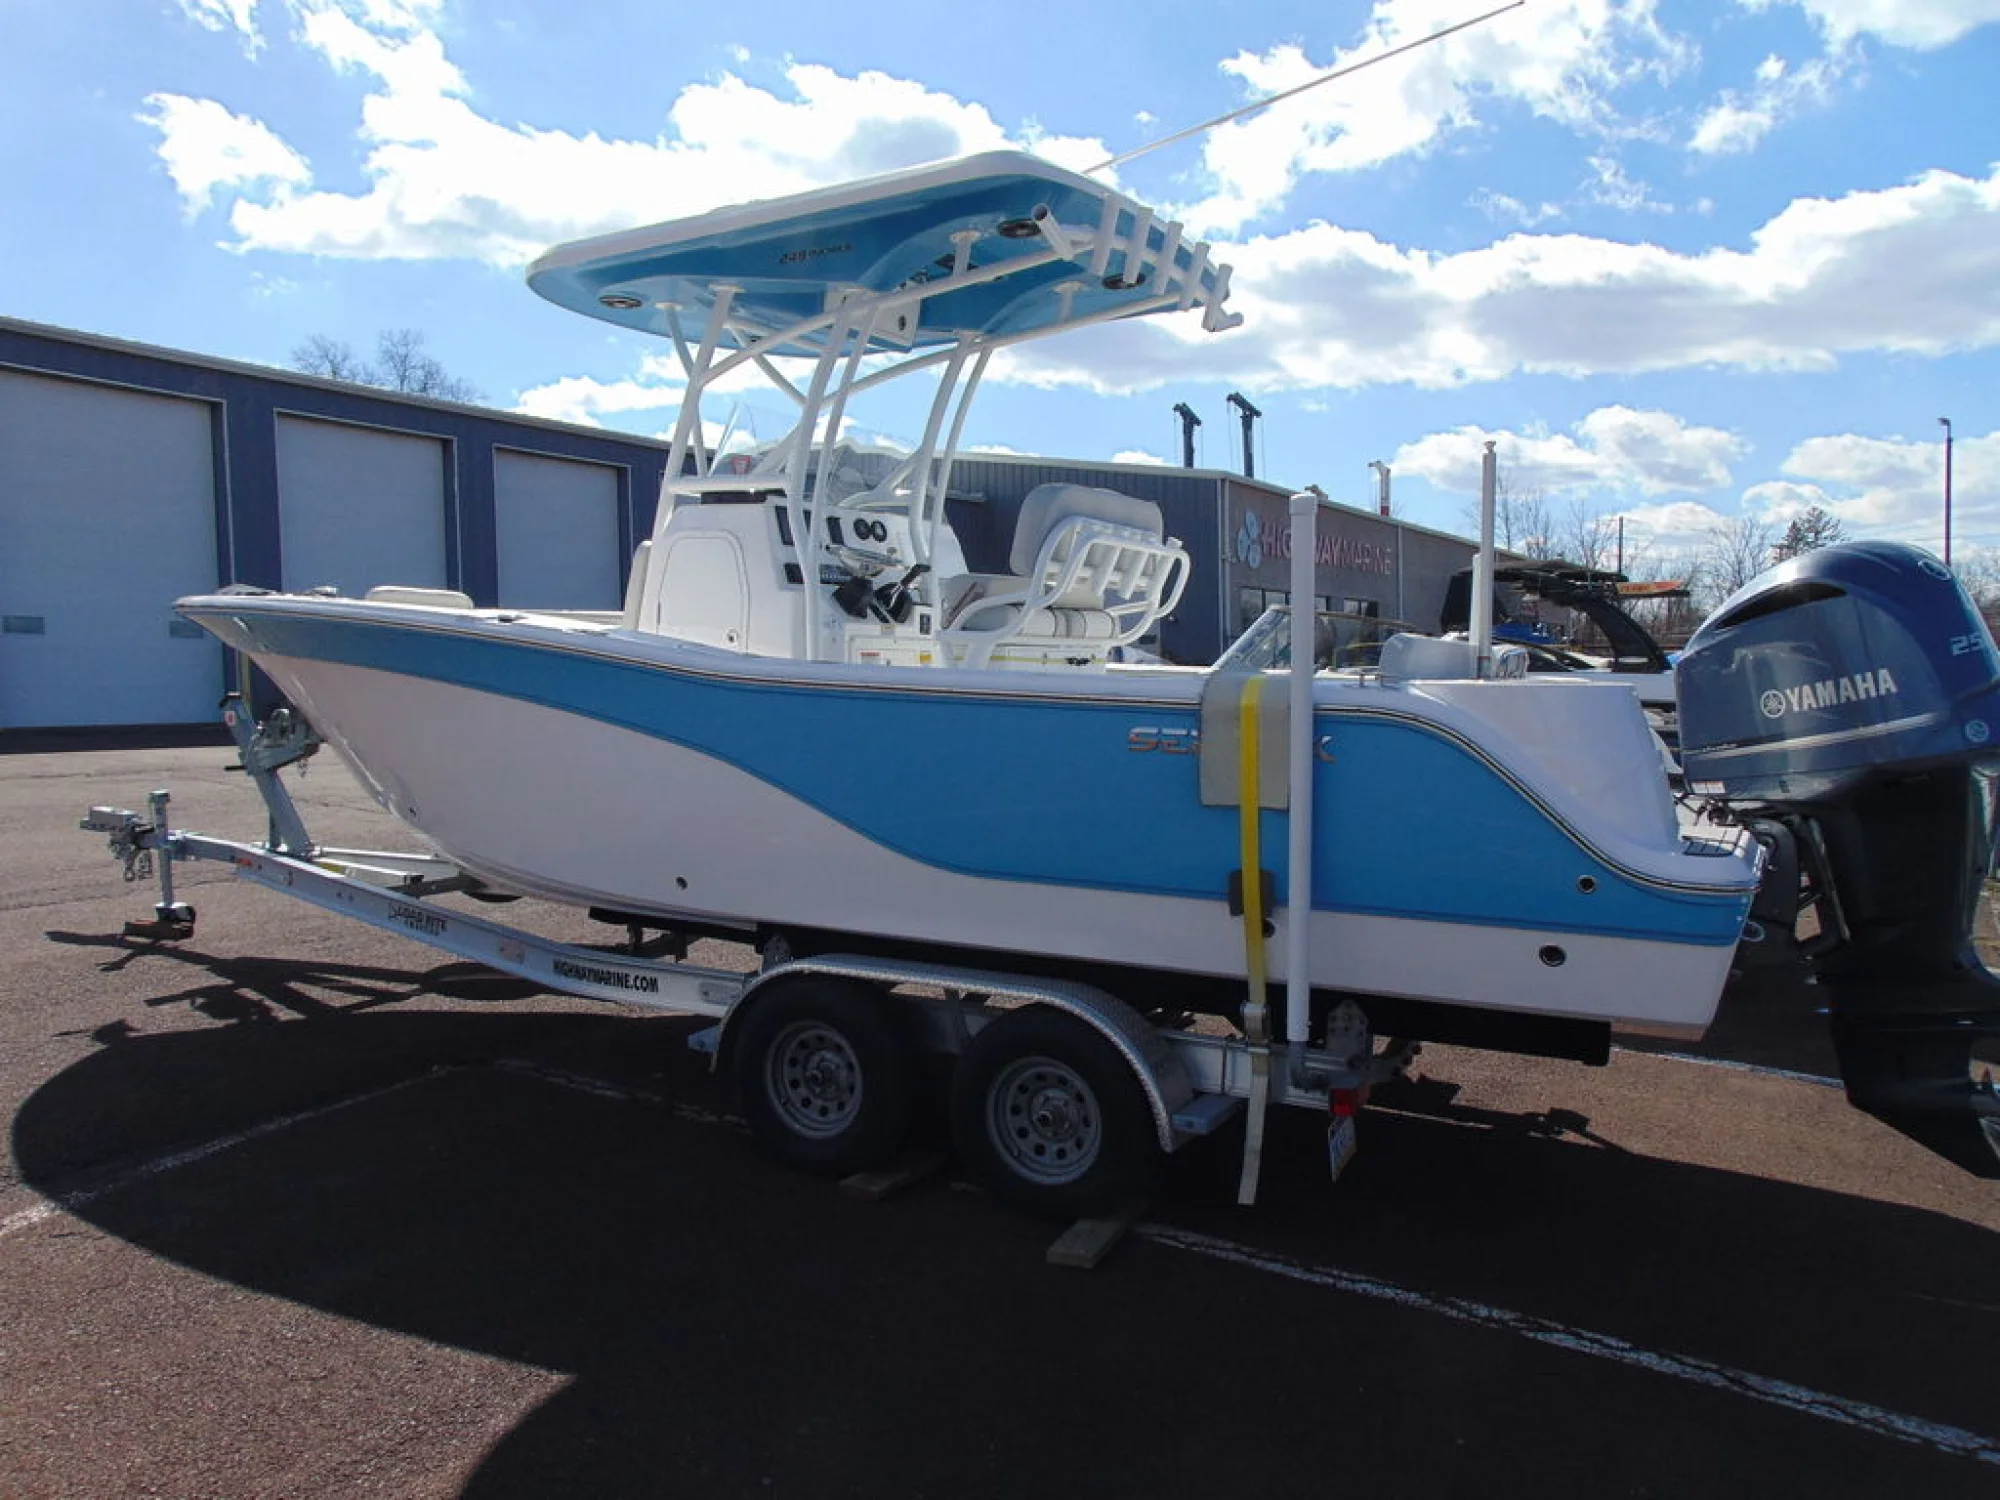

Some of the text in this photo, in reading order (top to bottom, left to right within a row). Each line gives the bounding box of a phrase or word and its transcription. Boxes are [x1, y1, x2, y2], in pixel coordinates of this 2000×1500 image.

[1261, 521, 1392, 575] HIGAYMARINE
[1784, 668, 1898, 712] YAMAHA
[1128, 726, 1200, 755] SE
[553, 959, 659, 993] HIGHWAYMARINE.COM
